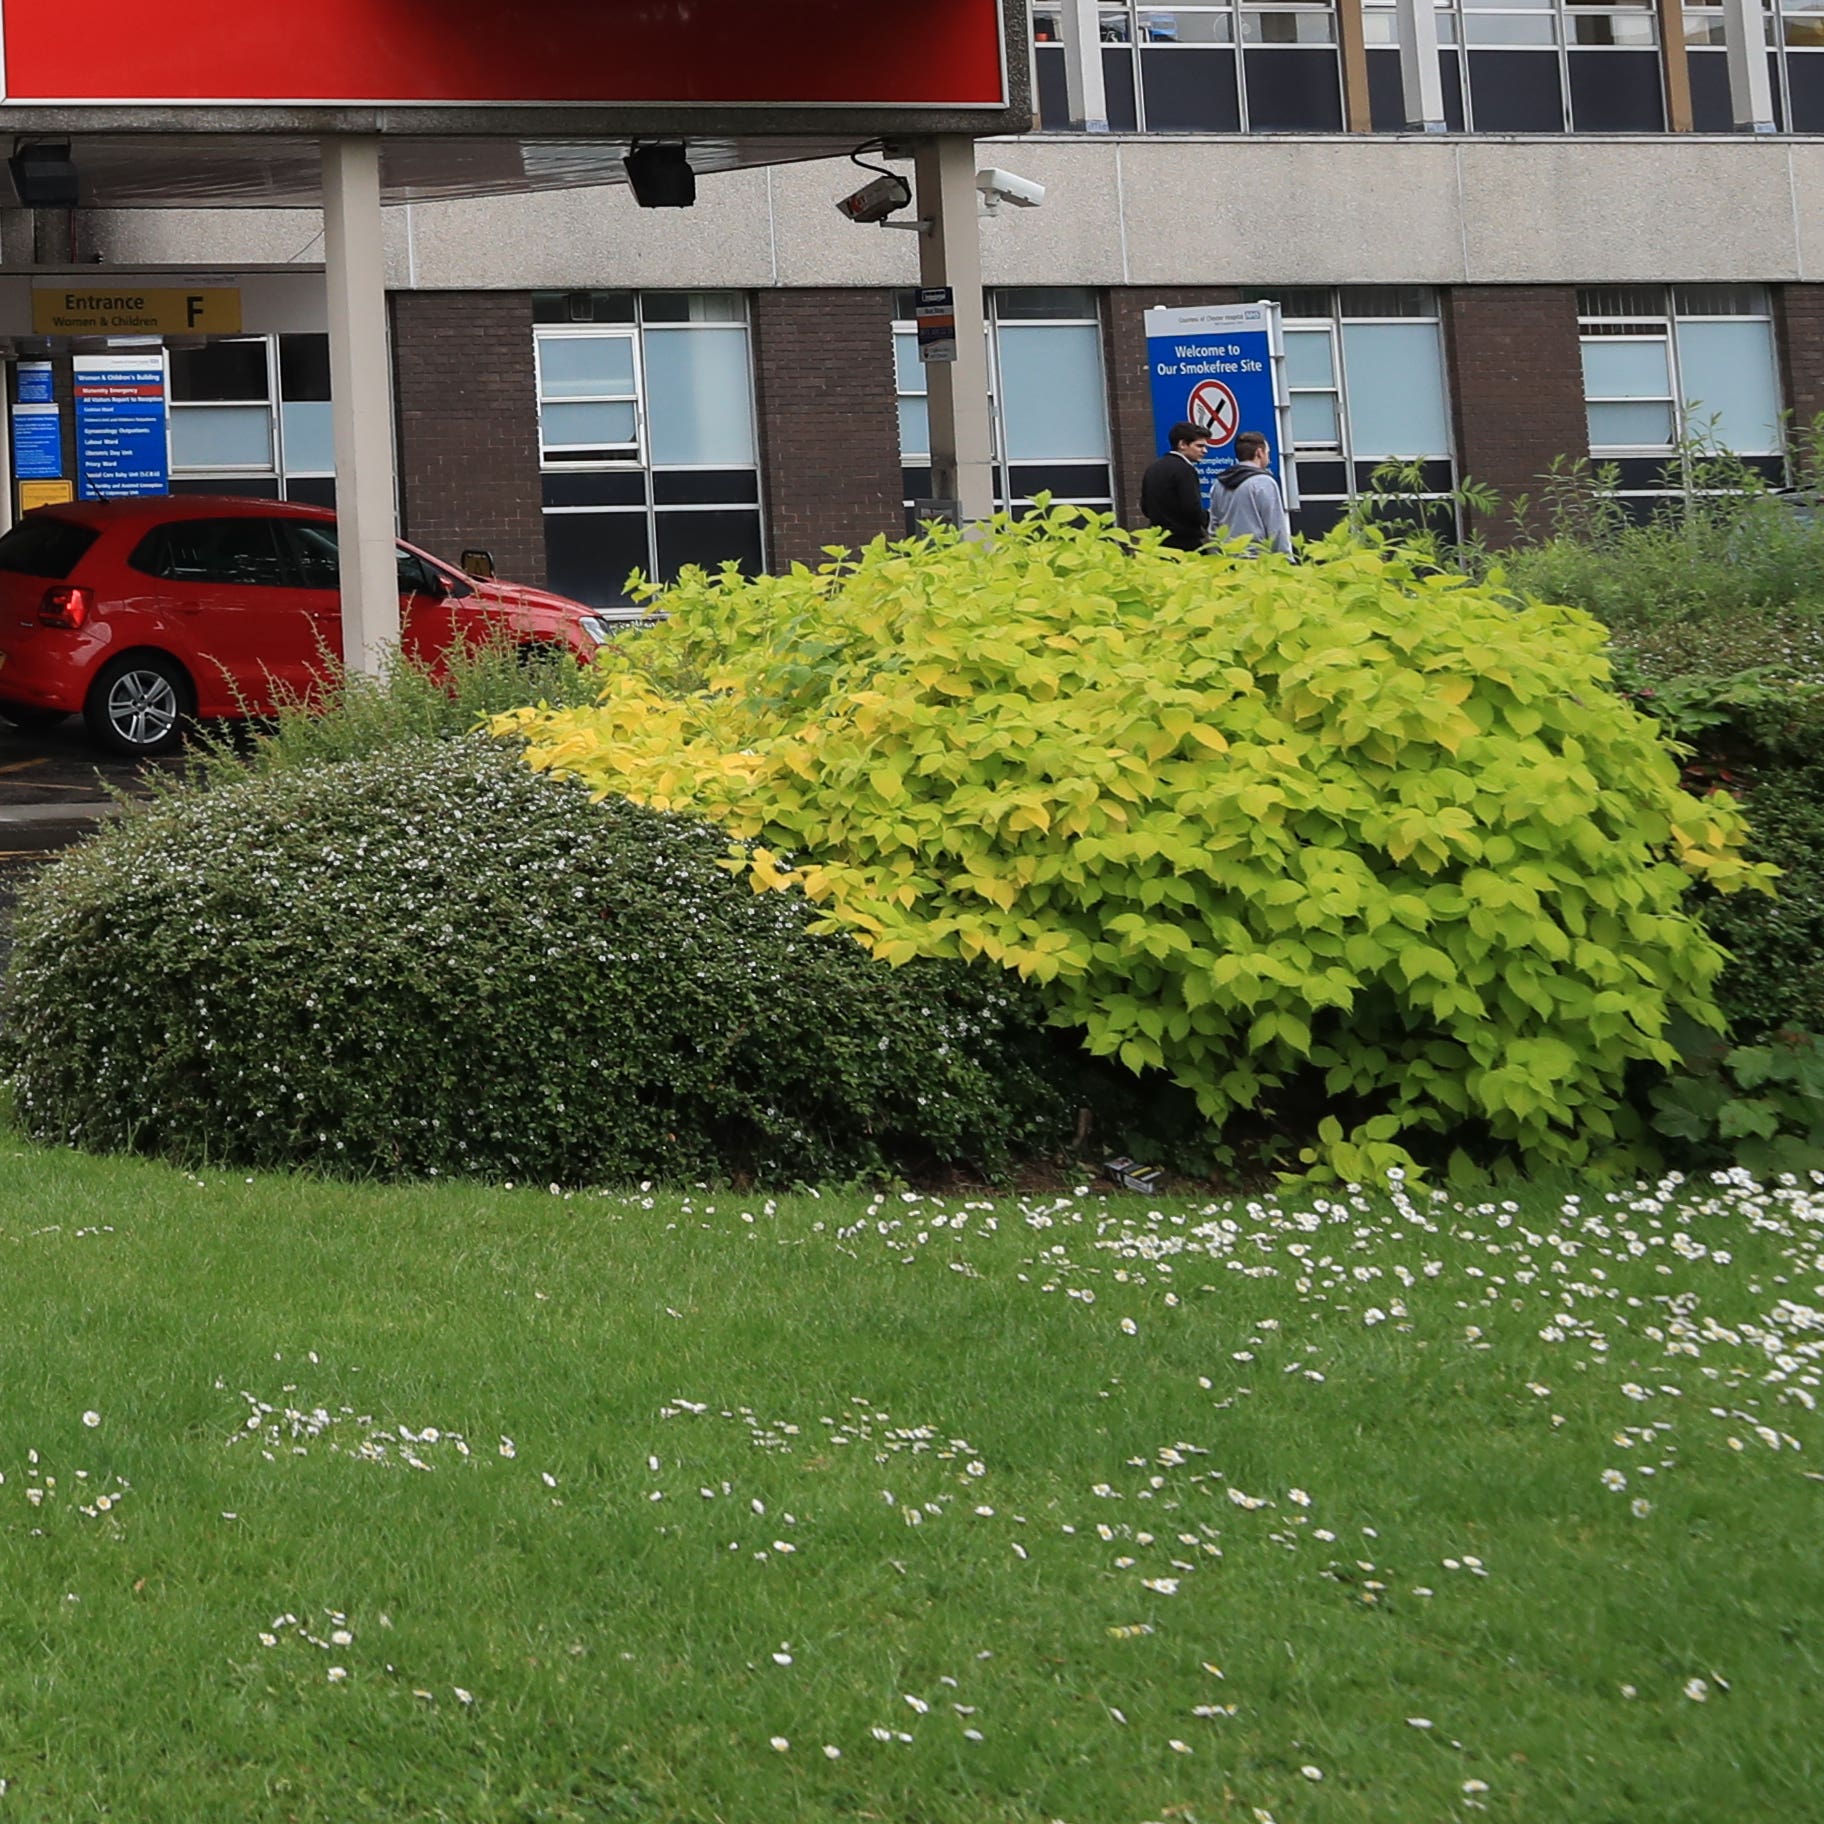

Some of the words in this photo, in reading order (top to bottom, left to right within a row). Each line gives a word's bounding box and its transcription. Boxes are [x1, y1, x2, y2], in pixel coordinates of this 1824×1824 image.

[64, 294, 145, 310] Entrance
[186, 295, 204, 328] F
[53, 317, 96, 327] Women
[100, 317, 107, 326] &
[111, 316, 158, 327] Children
[1175, 344, 1225, 358] Welcome
[1228, 344, 1240, 356] to
[1157, 363, 1177, 376] Our
[1180, 360, 1238, 375] Smokefree
[1240, 359, 1263, 372] Site
